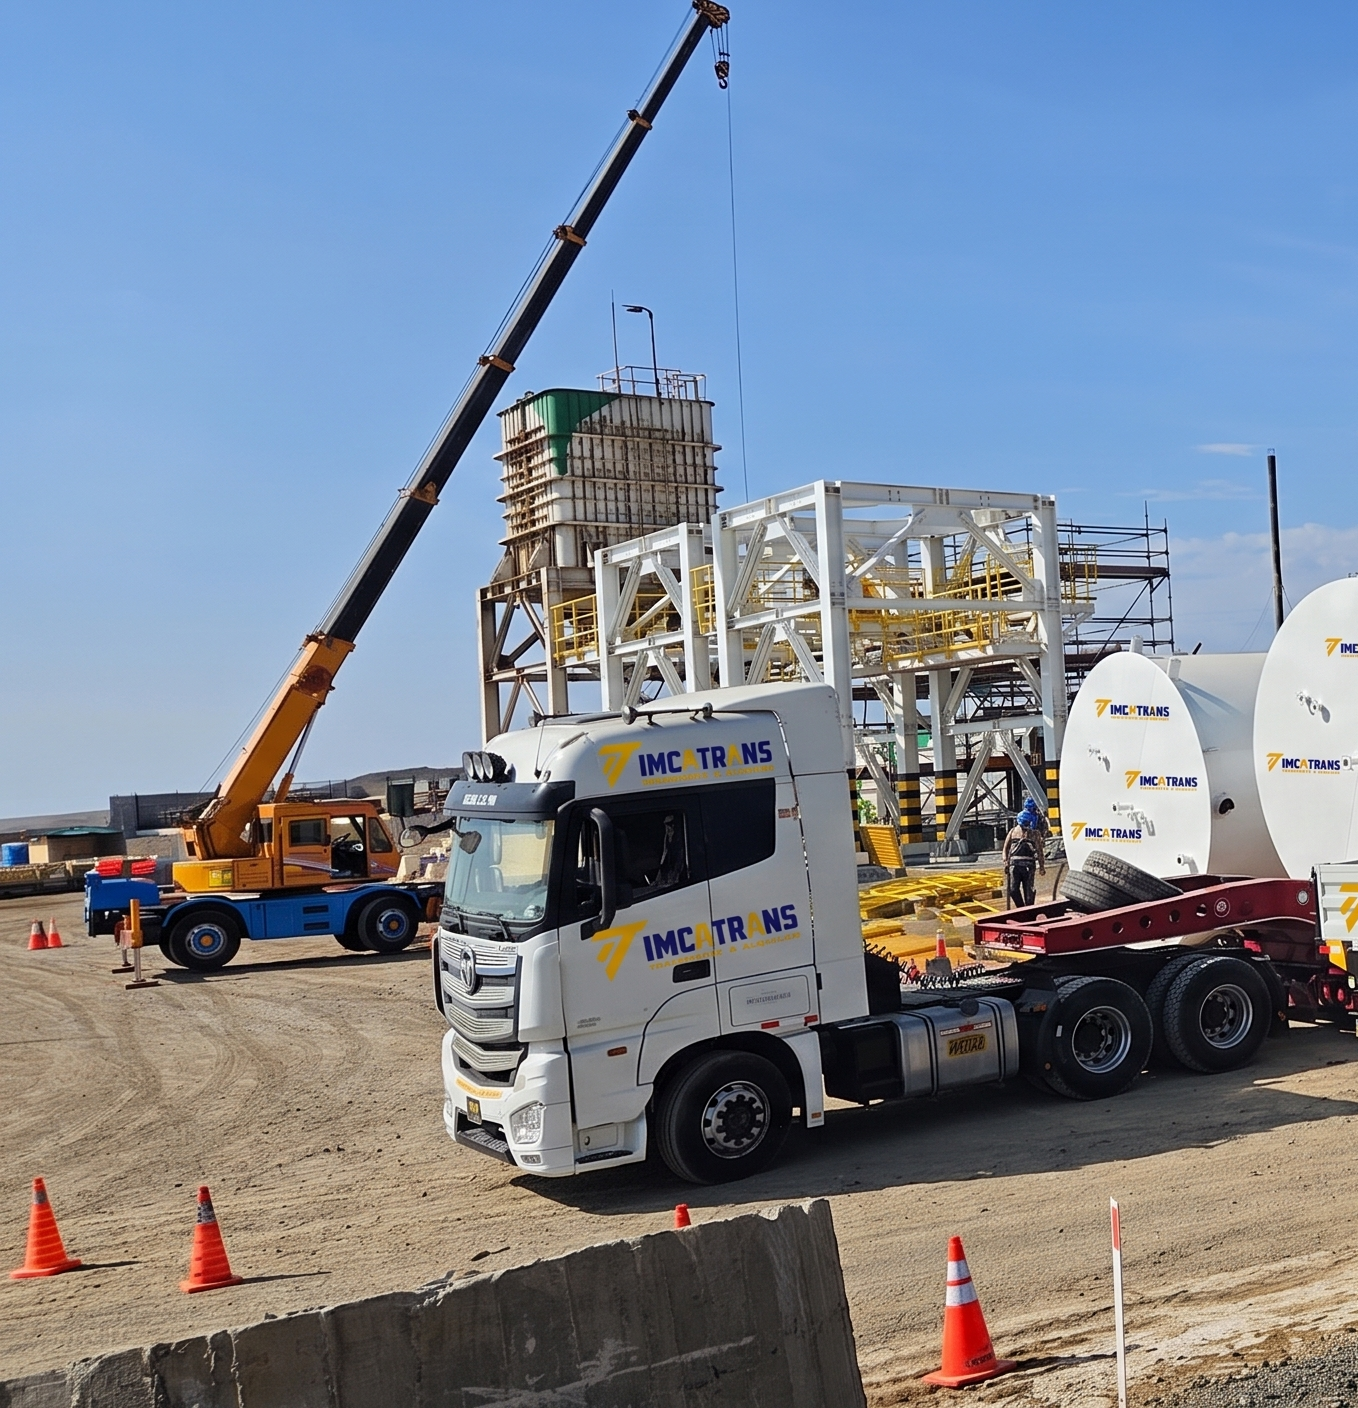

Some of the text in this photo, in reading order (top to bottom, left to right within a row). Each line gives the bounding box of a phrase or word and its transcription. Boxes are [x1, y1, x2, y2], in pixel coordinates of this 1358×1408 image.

[638, 740, 773, 777] IMCATRANS
[1282, 758, 1341, 770] IMCATRANS
[1139, 775, 1198, 787] IMCATRANS
[1085, 828, 1142, 839] IMCATRANS
[643, 904, 799, 962] IMCATRANS
